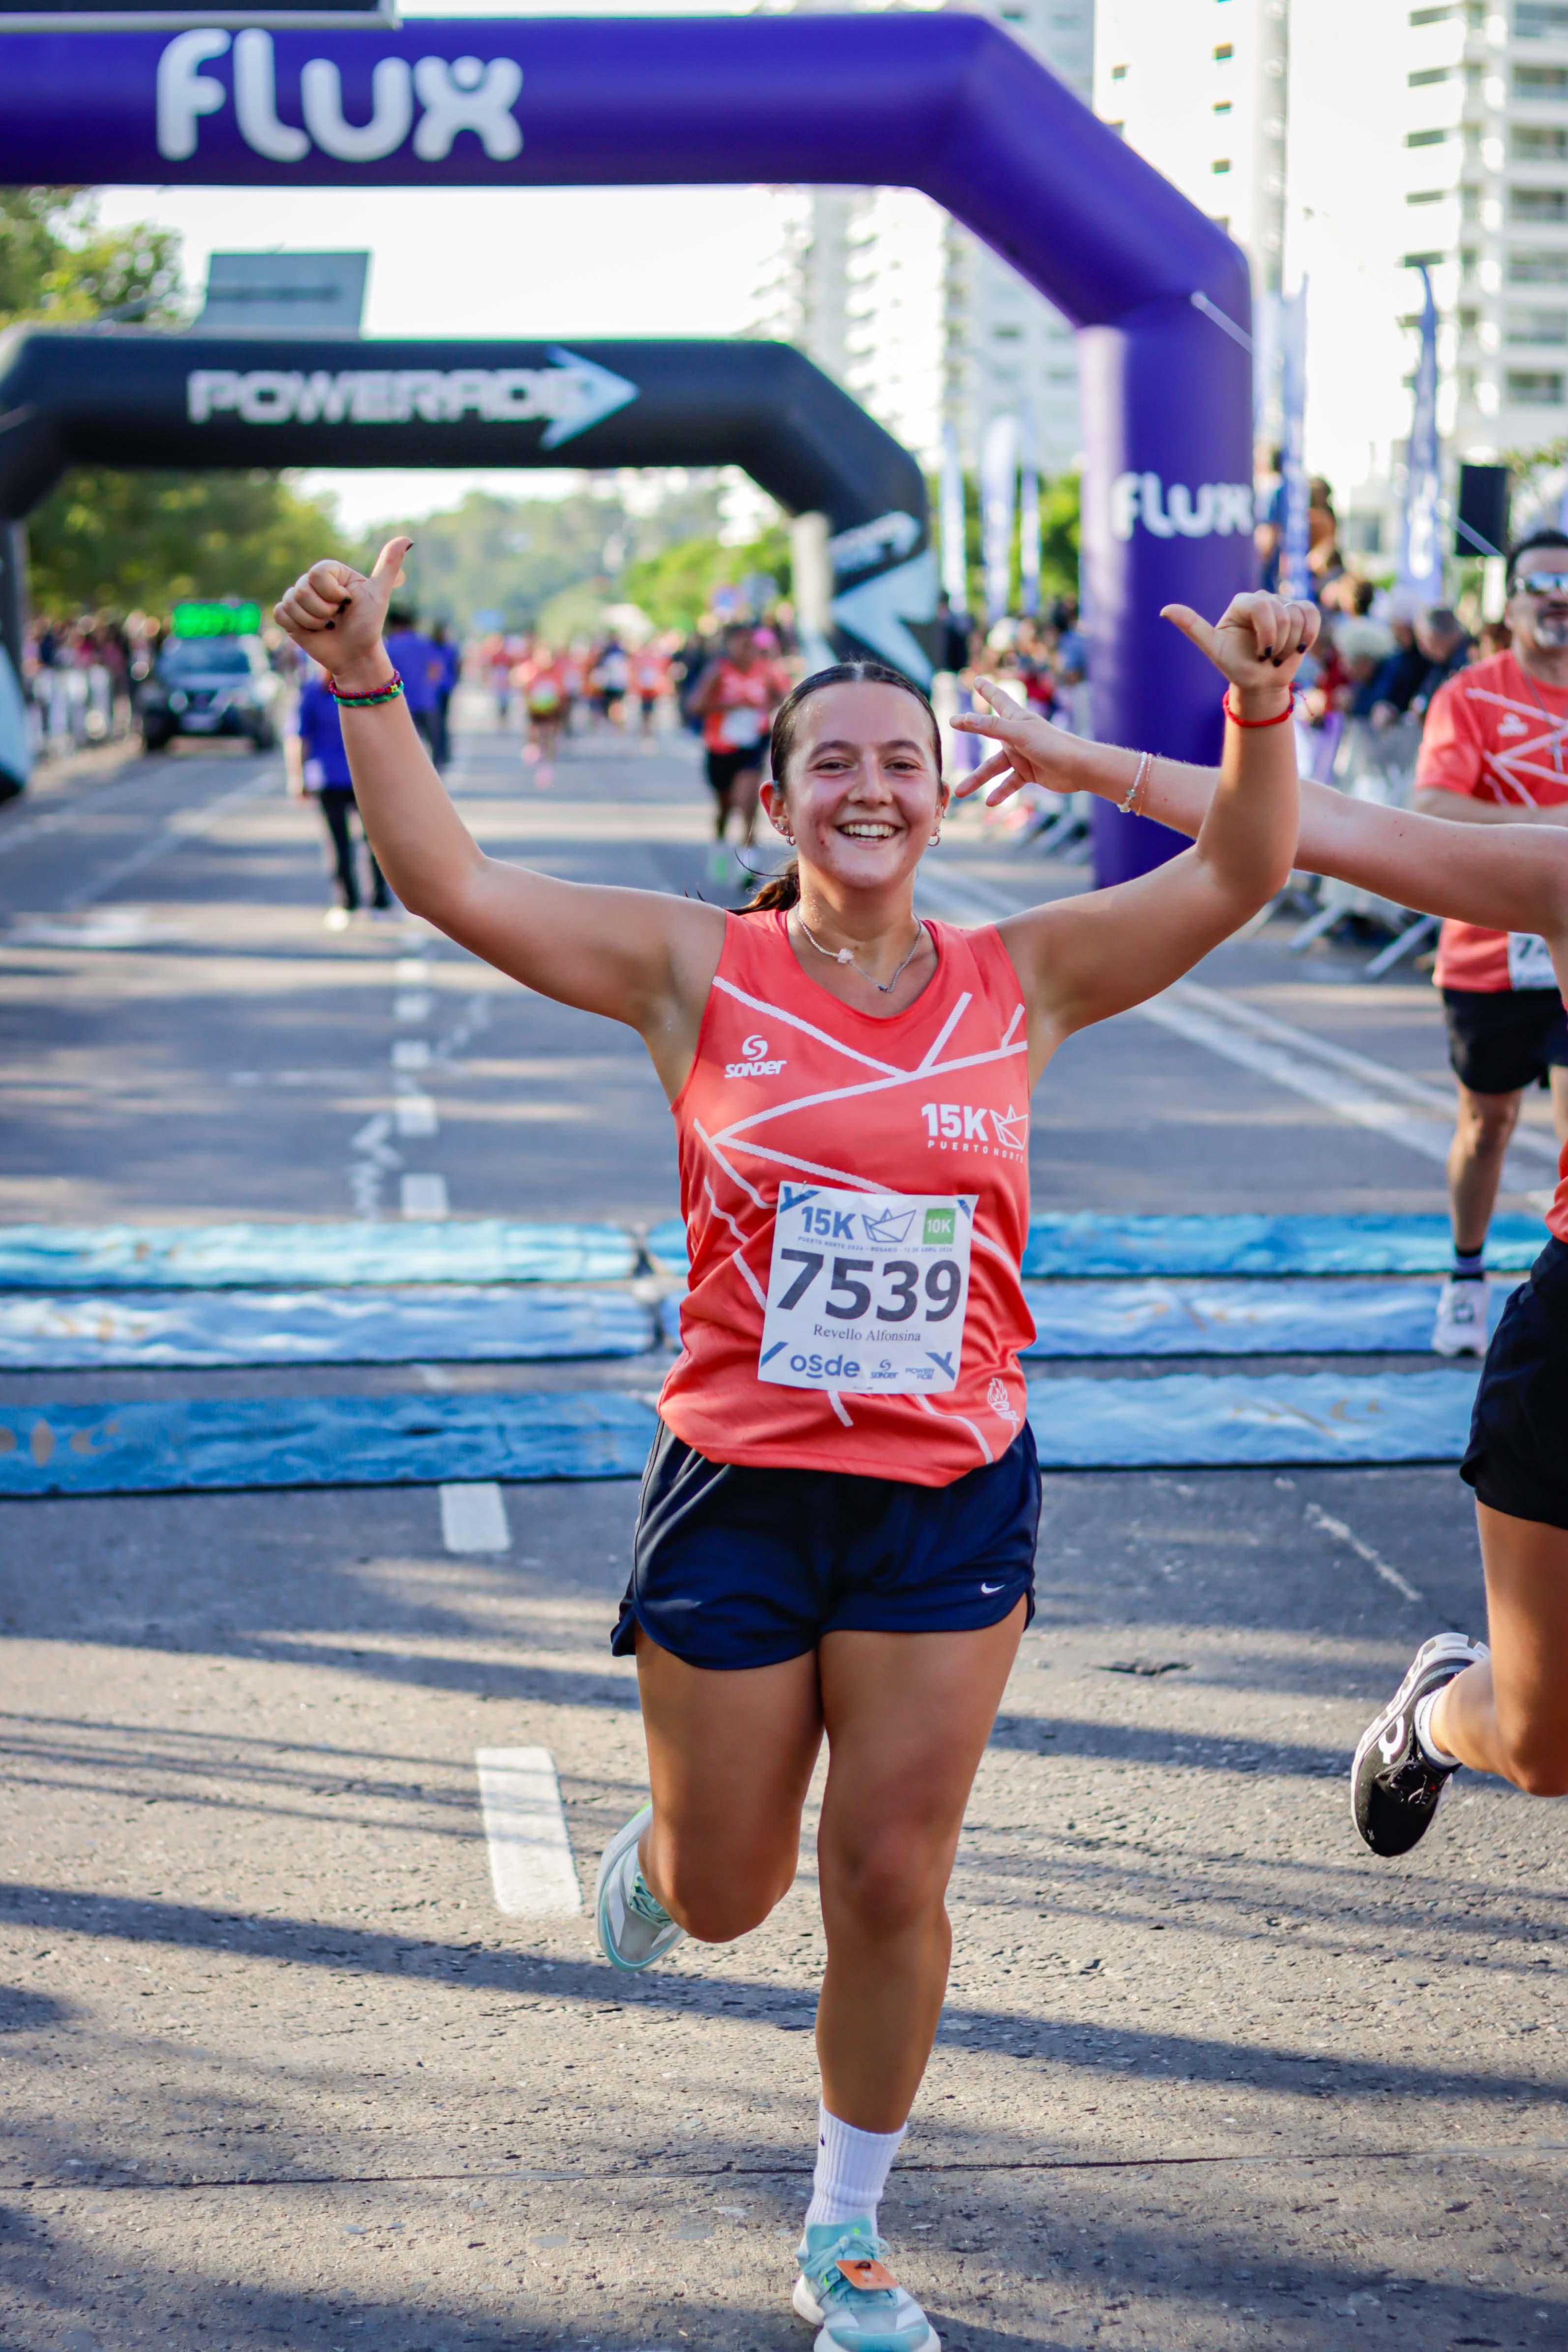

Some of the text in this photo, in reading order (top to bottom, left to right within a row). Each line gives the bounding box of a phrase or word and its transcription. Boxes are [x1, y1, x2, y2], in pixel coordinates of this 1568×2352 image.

[921, 1103, 988, 1142] 15K
[928, 1140, 1024, 1164] PUERTO NORTE
[801, 1206, 857, 1240] 15K
[927, 1218, 951, 1234] 10K
[798, 1236, 823, 1245] PUERTO
[825, 1240, 845, 1249] NORTE
[777, 1248, 961, 1322] 7539
[813, 1323, 921, 1342] Revello Alfonsina
[790, 1353, 860, 1378] osde
